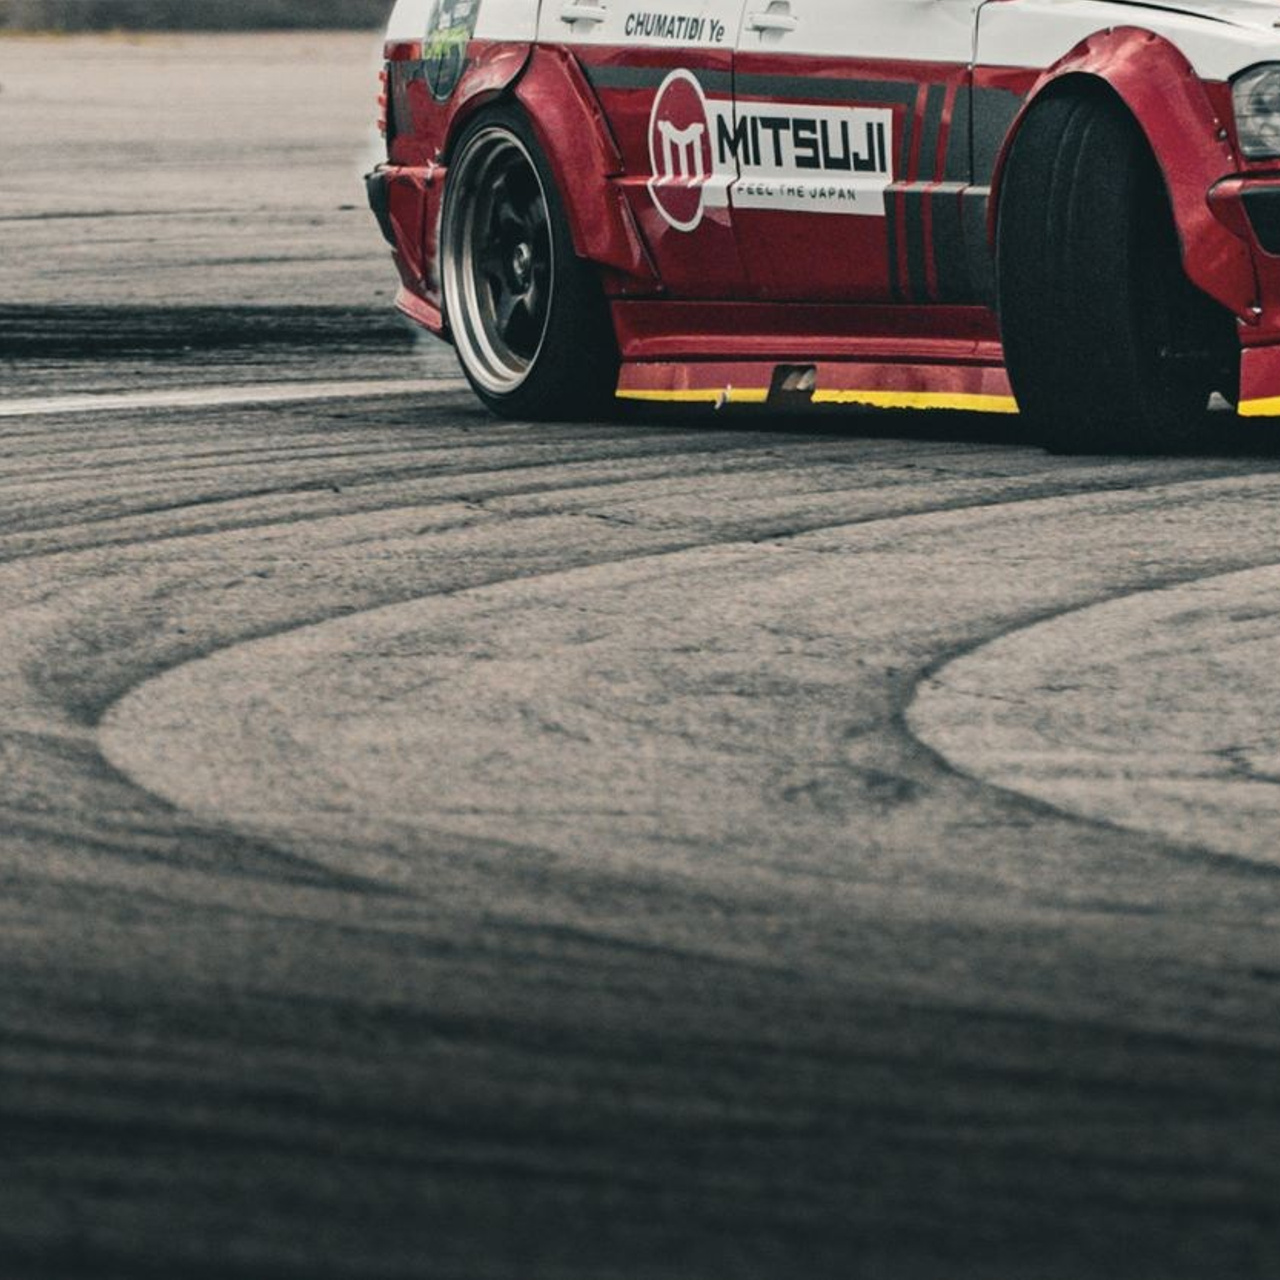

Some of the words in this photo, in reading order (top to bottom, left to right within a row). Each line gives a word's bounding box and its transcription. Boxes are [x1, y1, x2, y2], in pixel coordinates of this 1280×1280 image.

[716, 113, 887, 173] MITSUJI
[737, 183, 774, 196] FEEL
[809, 186, 857, 201] JAPAN
